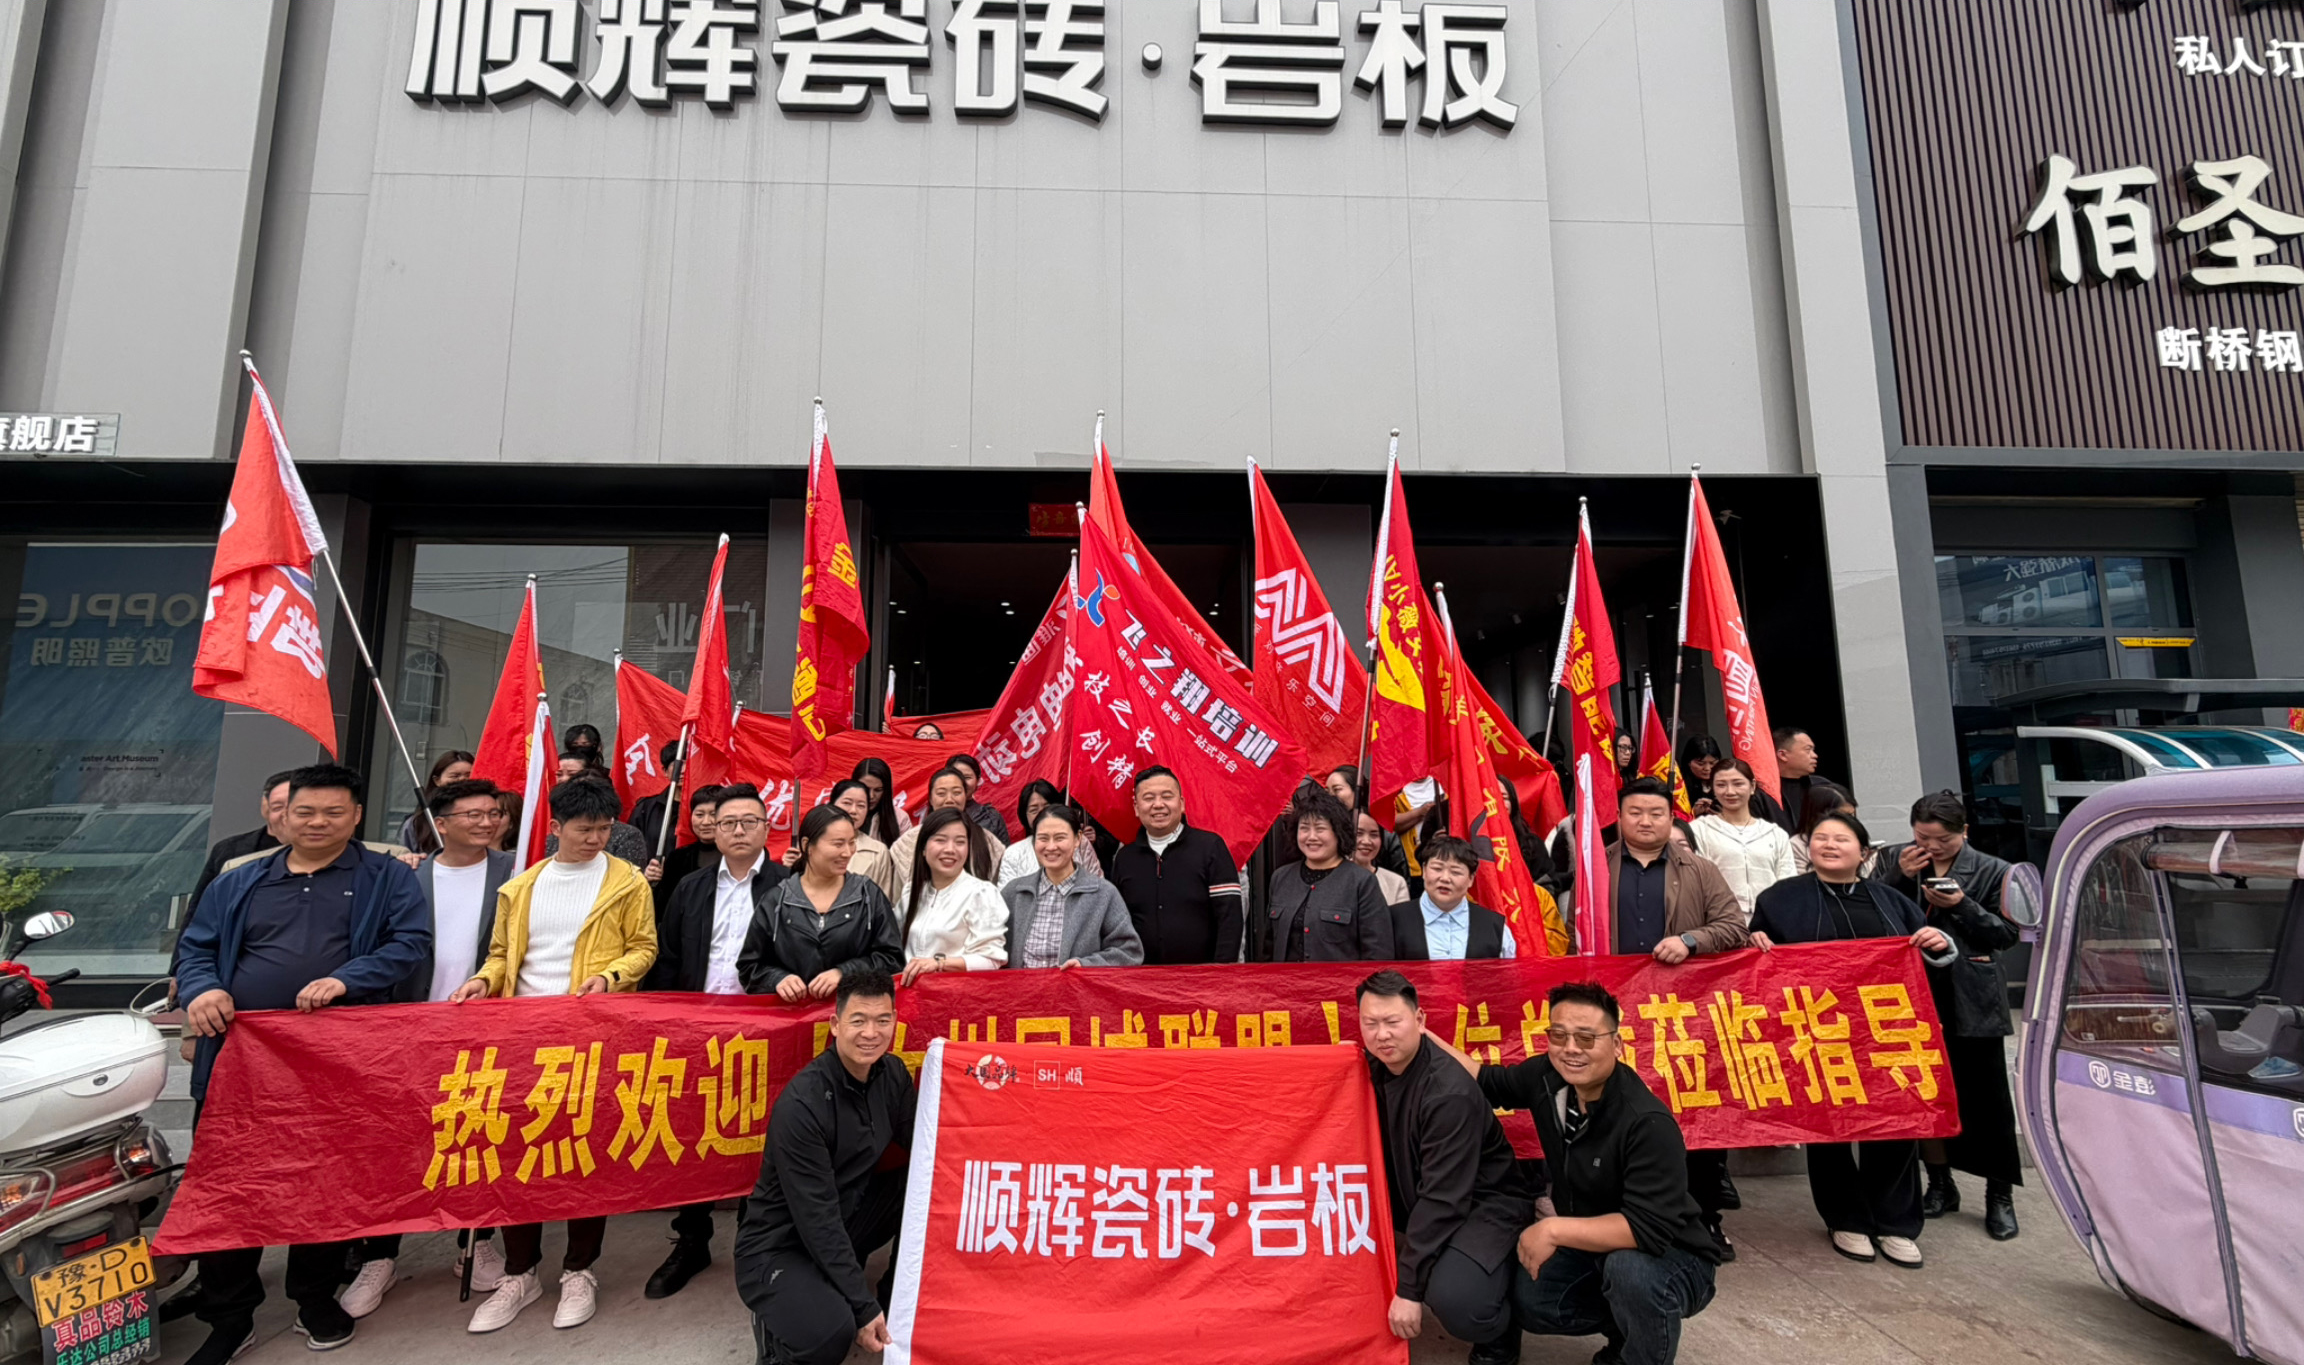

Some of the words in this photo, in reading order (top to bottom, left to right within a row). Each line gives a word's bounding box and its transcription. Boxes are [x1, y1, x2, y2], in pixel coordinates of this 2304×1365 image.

[2175, 35, 2304, 78] 私人订
[2018, 153, 2304, 289] 佰圣
[2156, 326, 2304, 372] 断桥钢
[0, 415, 98, 452] 舰店
[1120, 608, 1279, 769] 飞之翔培训
[1037, 1068, 1057, 1082] SH
[422, 1031, 769, 1190] 热烈欢迎
[955, 1159, 1377, 1260] 顺辉瓷砖·岩板
[44, 1261, 149, 1319] V3710
